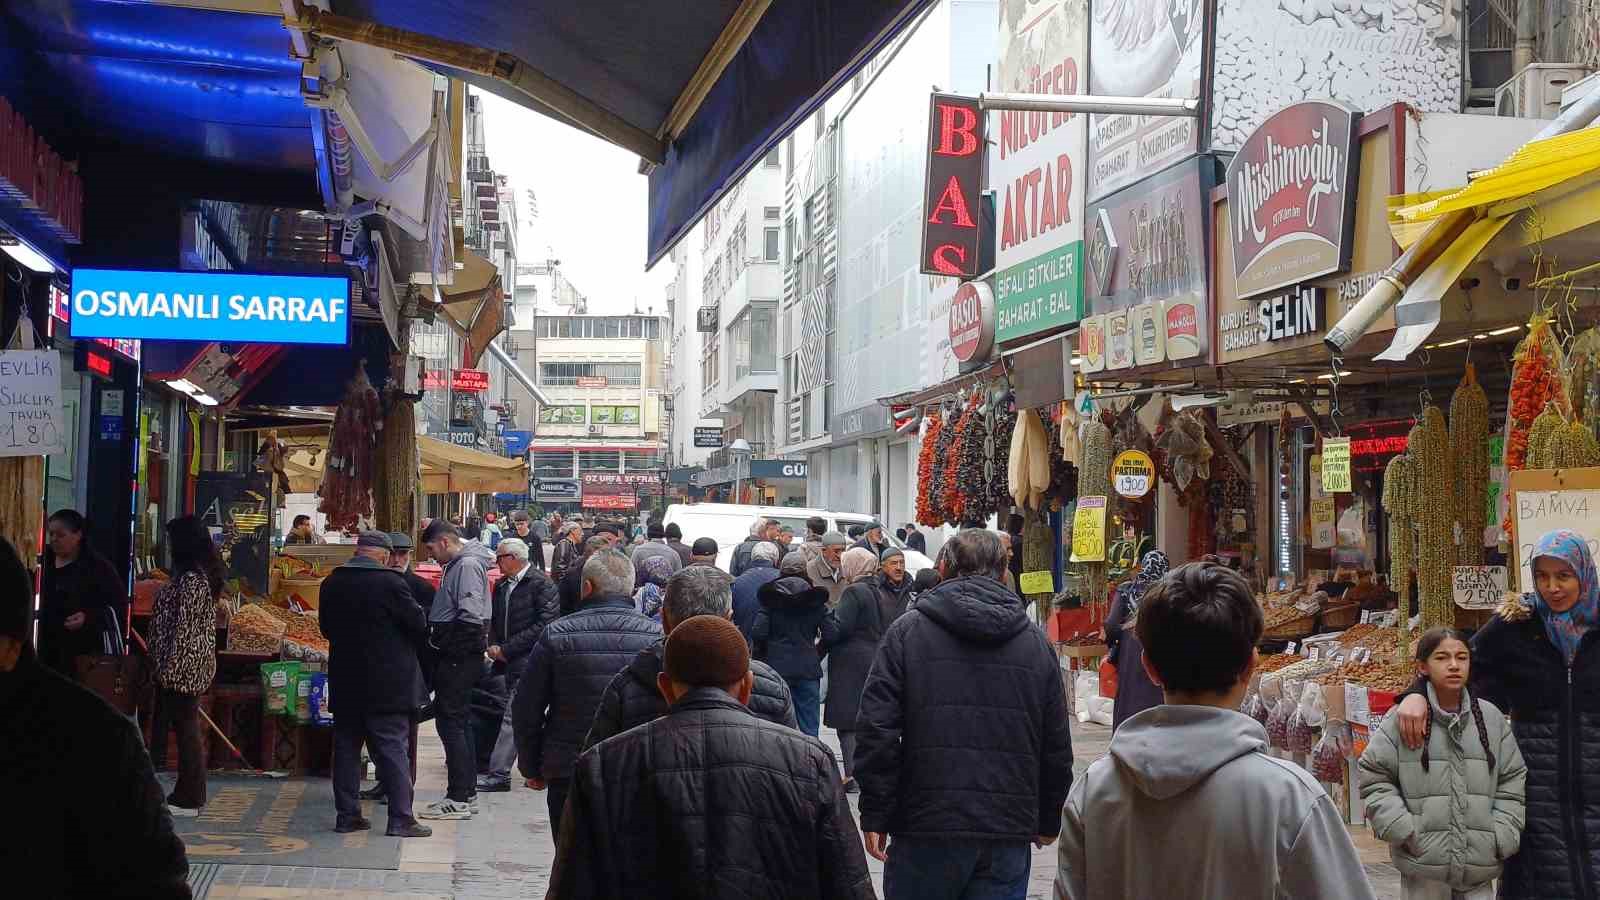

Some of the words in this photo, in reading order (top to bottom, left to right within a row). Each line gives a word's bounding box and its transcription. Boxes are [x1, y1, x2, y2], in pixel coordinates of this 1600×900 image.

[1001, 153, 1073, 251] AKTAR
[1028, 253, 1073, 289] BİTKİLER
[75, 289, 219, 320] OSMANLI
[228, 295, 345, 323] SARRAF
[998, 297, 1043, 330] BAHARAT
[1049, 289, 1072, 315] BAL
[1259, 284, 1317, 342] SELİN
[1224, 328, 1258, 351] BAHARAT
[451, 432, 475, 444] FOTO
